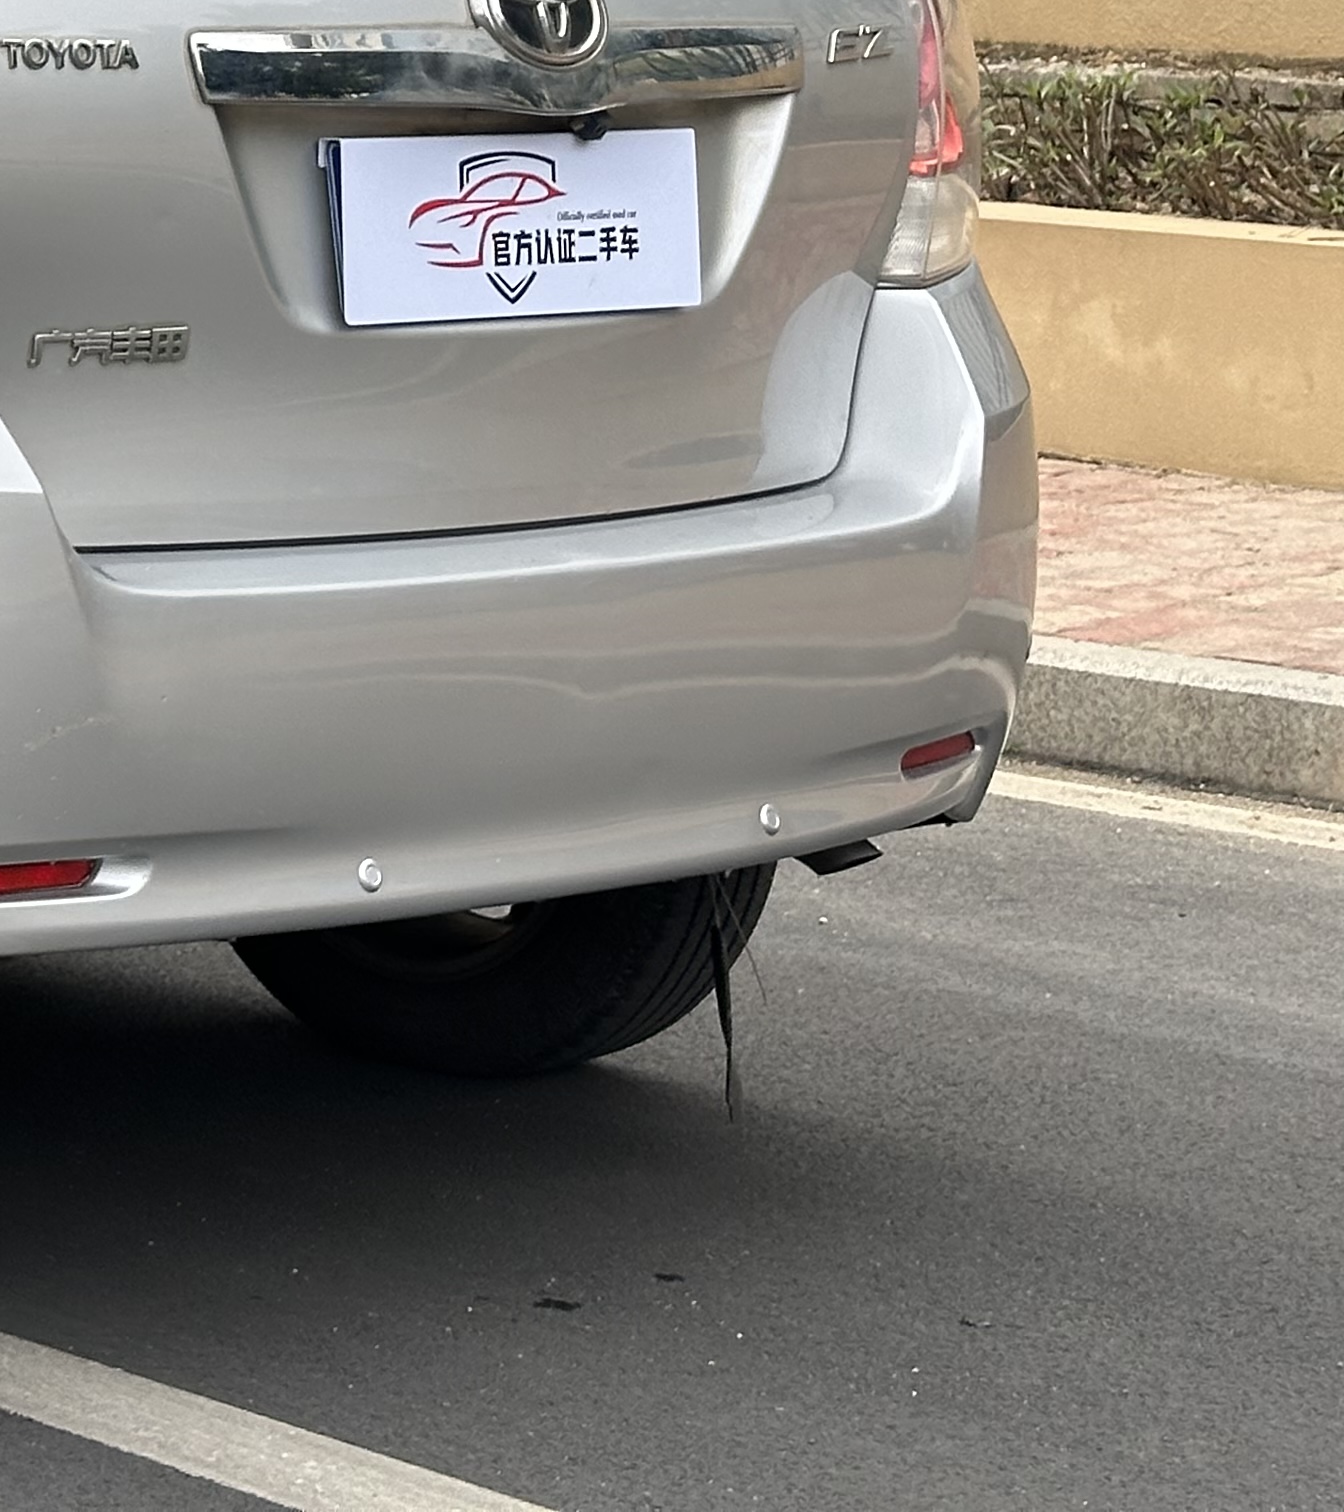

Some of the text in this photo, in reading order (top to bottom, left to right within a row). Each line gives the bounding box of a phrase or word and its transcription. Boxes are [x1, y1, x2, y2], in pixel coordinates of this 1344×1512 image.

[0, 38, 140, 71] TOYOTA
[492, 224, 640, 267] 官方认证二手车
